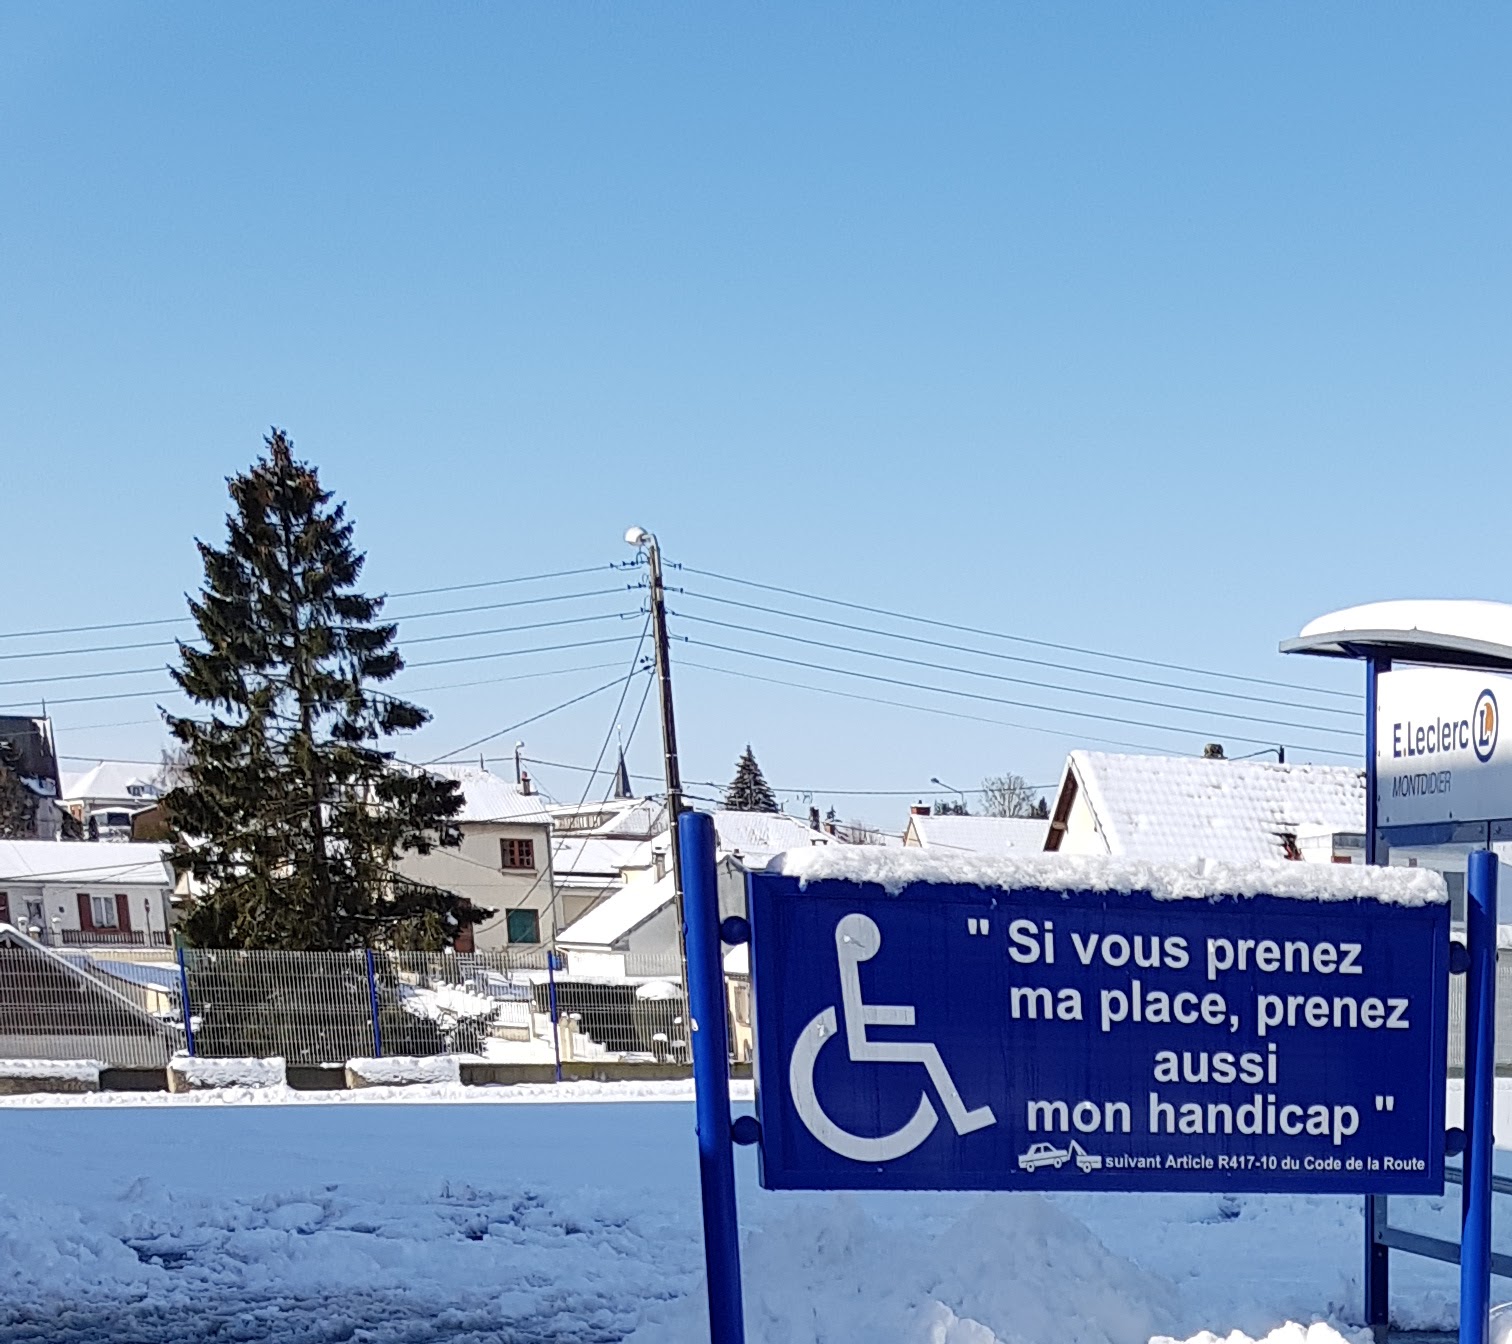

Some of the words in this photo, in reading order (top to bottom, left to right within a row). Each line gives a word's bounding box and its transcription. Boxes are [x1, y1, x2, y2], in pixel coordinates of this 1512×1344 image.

[1393, 716, 1469, 759] E.Leclerc
[1392, 770, 1452, 798] MONTDIDIER
[1008, 919, 1055, 964] Si
[1070, 933, 1190, 969] vous
[1207, 938, 1363, 981] prenez
[1010, 987, 1083, 1021] ma
[1100, 979, 1239, 1033] place,
[1257, 994, 1410, 1037] prenez
[1153, 1042, 1277, 1084] aussi
[1027, 1100, 1131, 1133] mon
[1149, 1092, 1360, 1146] handicap
[1105, 1154, 1162, 1169] suivant
[1165, 1154, 1214, 1169] Article
[1218, 1155, 1278, 1170] R417-10
[1281, 1155, 1300, 1170] du
[1303, 1156, 1342, 1171] Code
[1345, 1156, 1363, 1171] de
[1367, 1156, 1380, 1171] la
[1383, 1156, 1425, 1171] Route
